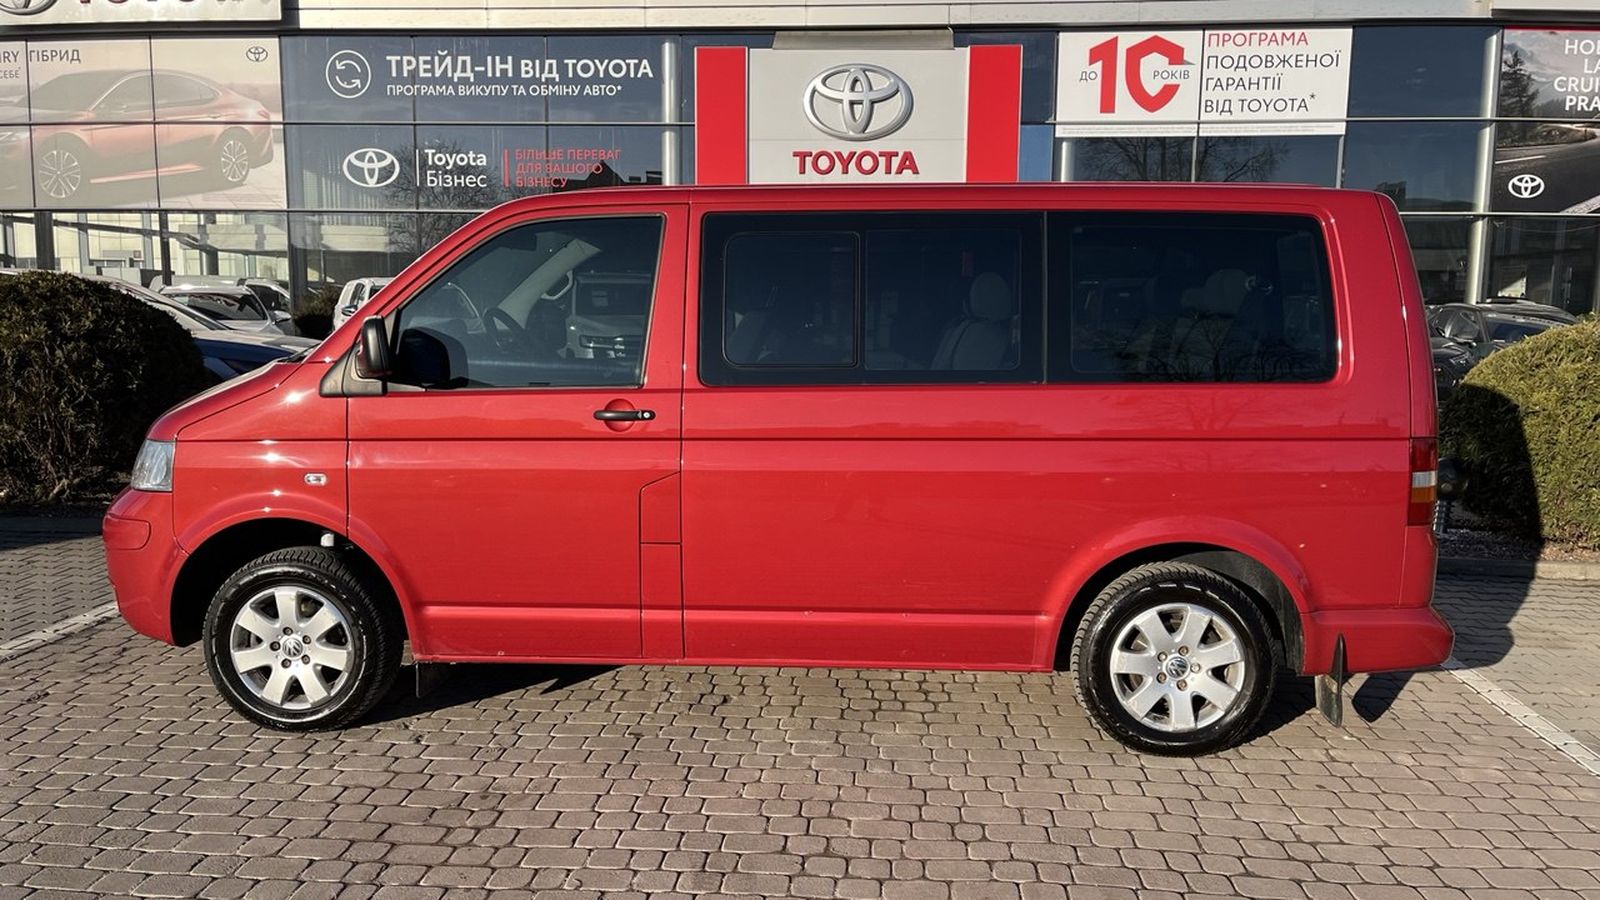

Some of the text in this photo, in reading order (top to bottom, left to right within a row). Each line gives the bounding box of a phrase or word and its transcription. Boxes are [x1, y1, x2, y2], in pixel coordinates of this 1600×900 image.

[1207, 32, 1309, 47] ПРОГРАМА
[0, 49, 81, 64] RY ГІБРИД
[1206, 50, 1342, 71] ПОДОВЖЕНОЇ
[386, 51, 654, 82] ТРЕЙД-ІН ВІД TOYOTA
[1079, 71, 1098, 82] ДО
[1153, 70, 1190, 80] РОКІВ
[1205, 73, 1283, 92] ГАРАНТІЇ
[386, 84, 455, 97] ПРОГРАМА
[458, 84, 509, 97] ВИКУПУ
[511, 84, 527, 96] ТА
[529, 84, 581, 96] ОБМІНУ
[1553, 76, 1600, 93] CRUI
[1204, 99, 1233, 115] ВІД
[425, 149, 487, 169] Toyota
[516, 149, 621, 160] БІЛЬШЕ ПЕРЕВАГ
[516, 163, 603, 174] ДЛЯ ВАШОГО
[792, 150, 920, 176] TOYOTA
[427, 169, 487, 188] Бізнес
[516, 176, 568, 187] БІЗНЕСУ
